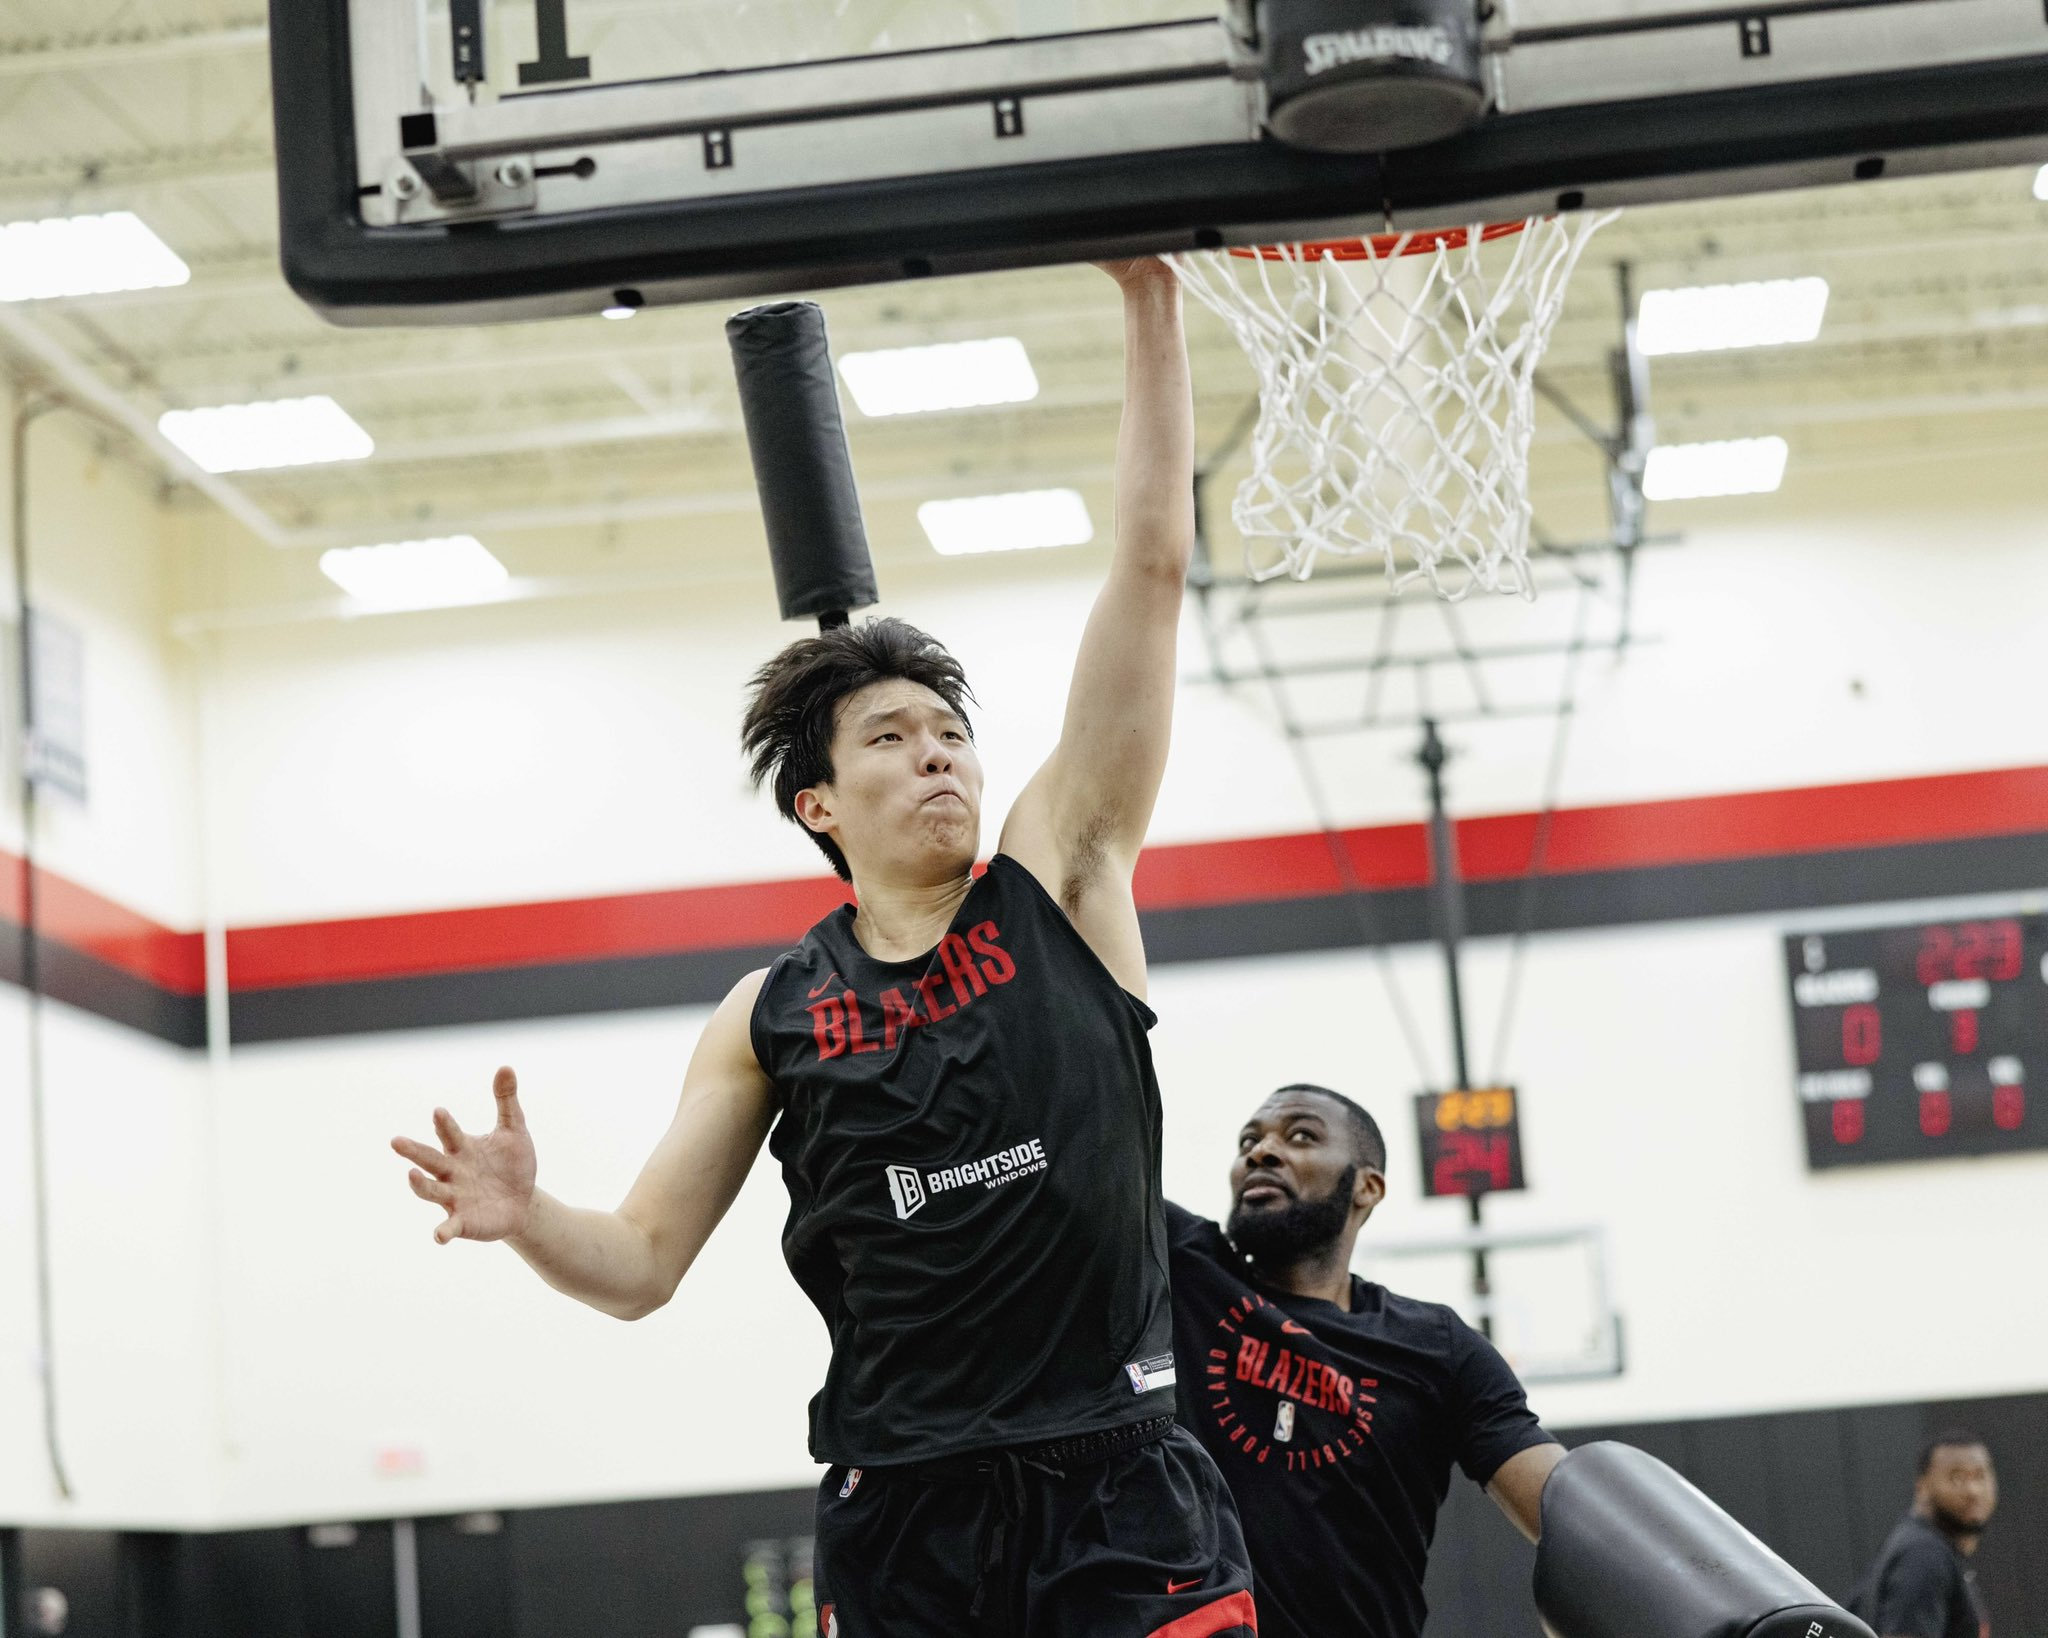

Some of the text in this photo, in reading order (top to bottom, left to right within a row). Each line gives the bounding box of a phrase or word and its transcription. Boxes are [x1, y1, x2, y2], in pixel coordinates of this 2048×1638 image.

[1302, 25, 1453, 75] SPALDING
[805, 920, 1017, 1062] BLAERS
[926, 1138, 1046, 1194] BRIGHTSIDE
[984, 1159, 1048, 1190] WINDOWS
[1206, 1294, 1379, 1472] PORTLAND TRAI BASKETBALL
[1235, 1334, 1354, 1417] BLAZERS
